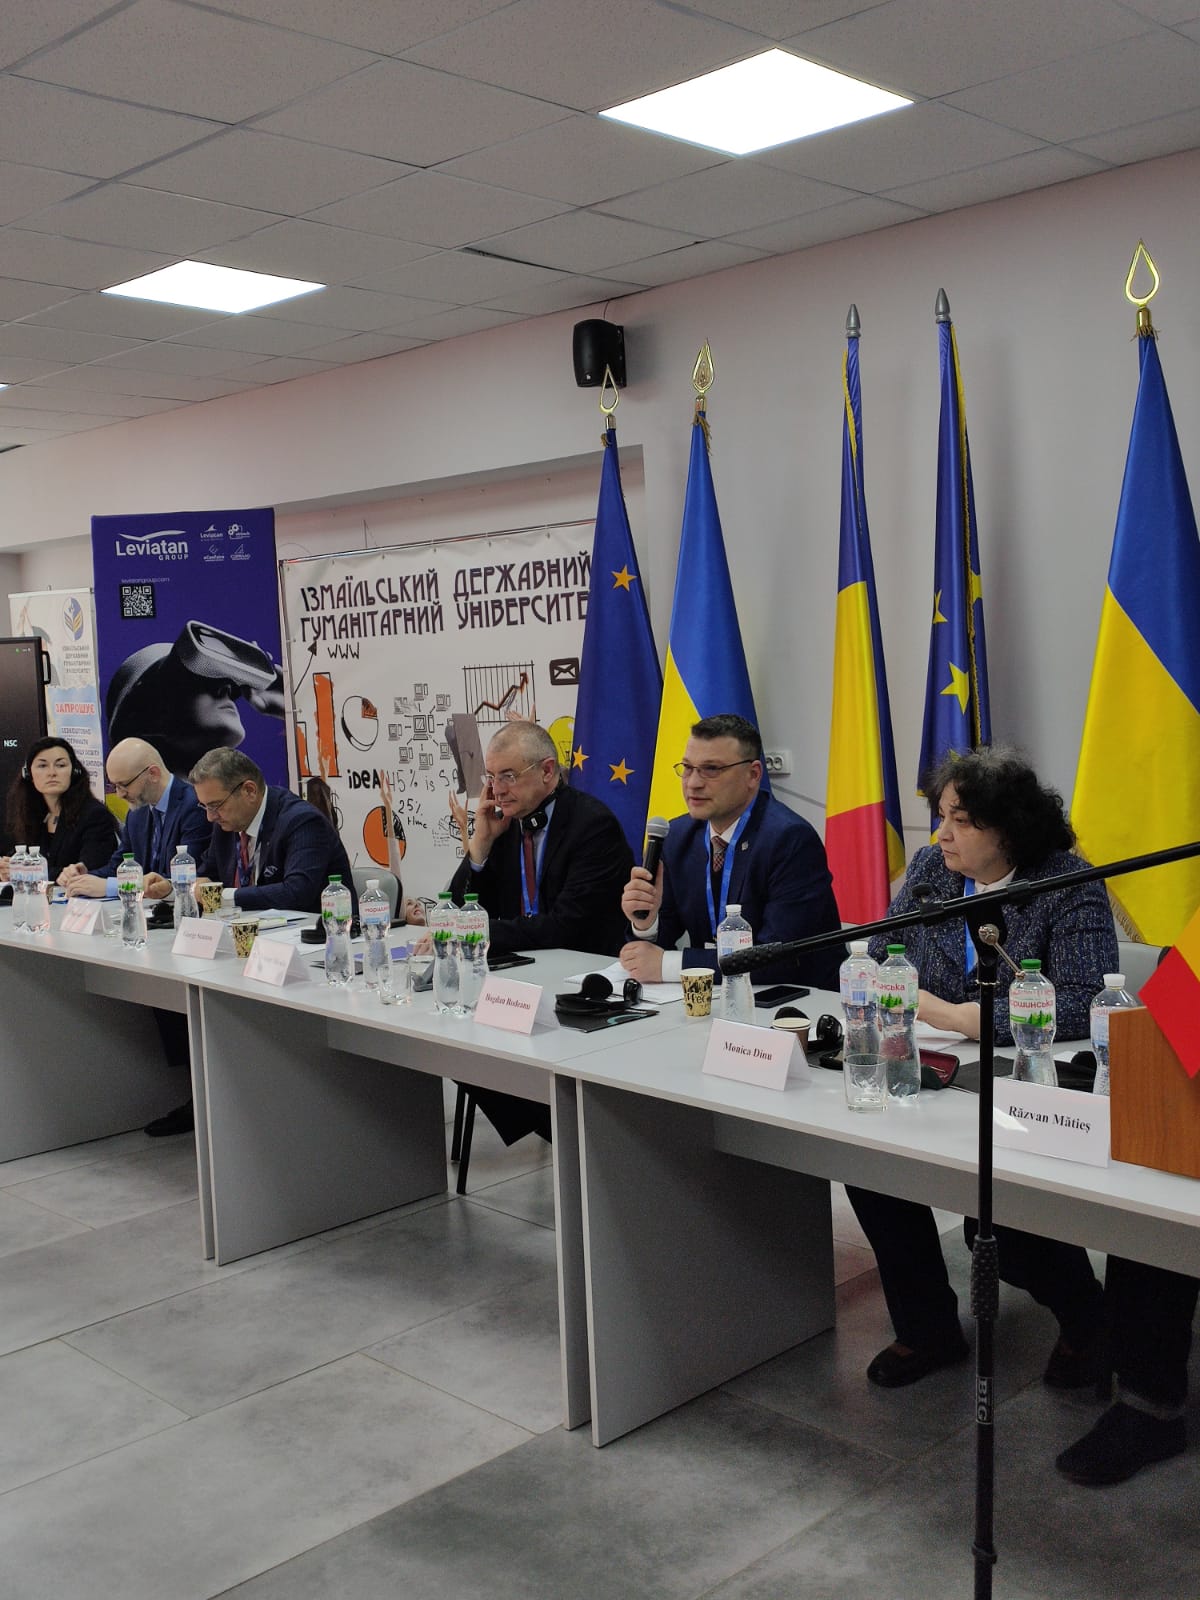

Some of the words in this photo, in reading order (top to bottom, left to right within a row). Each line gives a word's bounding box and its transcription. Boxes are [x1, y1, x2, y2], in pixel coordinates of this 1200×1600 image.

[115, 540, 188, 556] Leviatan
[300, 568, 439, 612] ІЗМАЇЛЬСЬКИЙ
[453, 550, 591, 602] ДЕРЖАВНИЙ
[300, 600, 444, 642] ГУМАНІТАРНИЙ
[456, 591, 588, 630] УНІВЕРСИТЕ
[425, 775, 435, 792] is
[398, 798, 423, 816] 25%
[723, 1041, 751, 1056] Monica
[753, 1048, 772, 1061] Dinu
[1009, 1105, 1048, 1123] Răzvan
